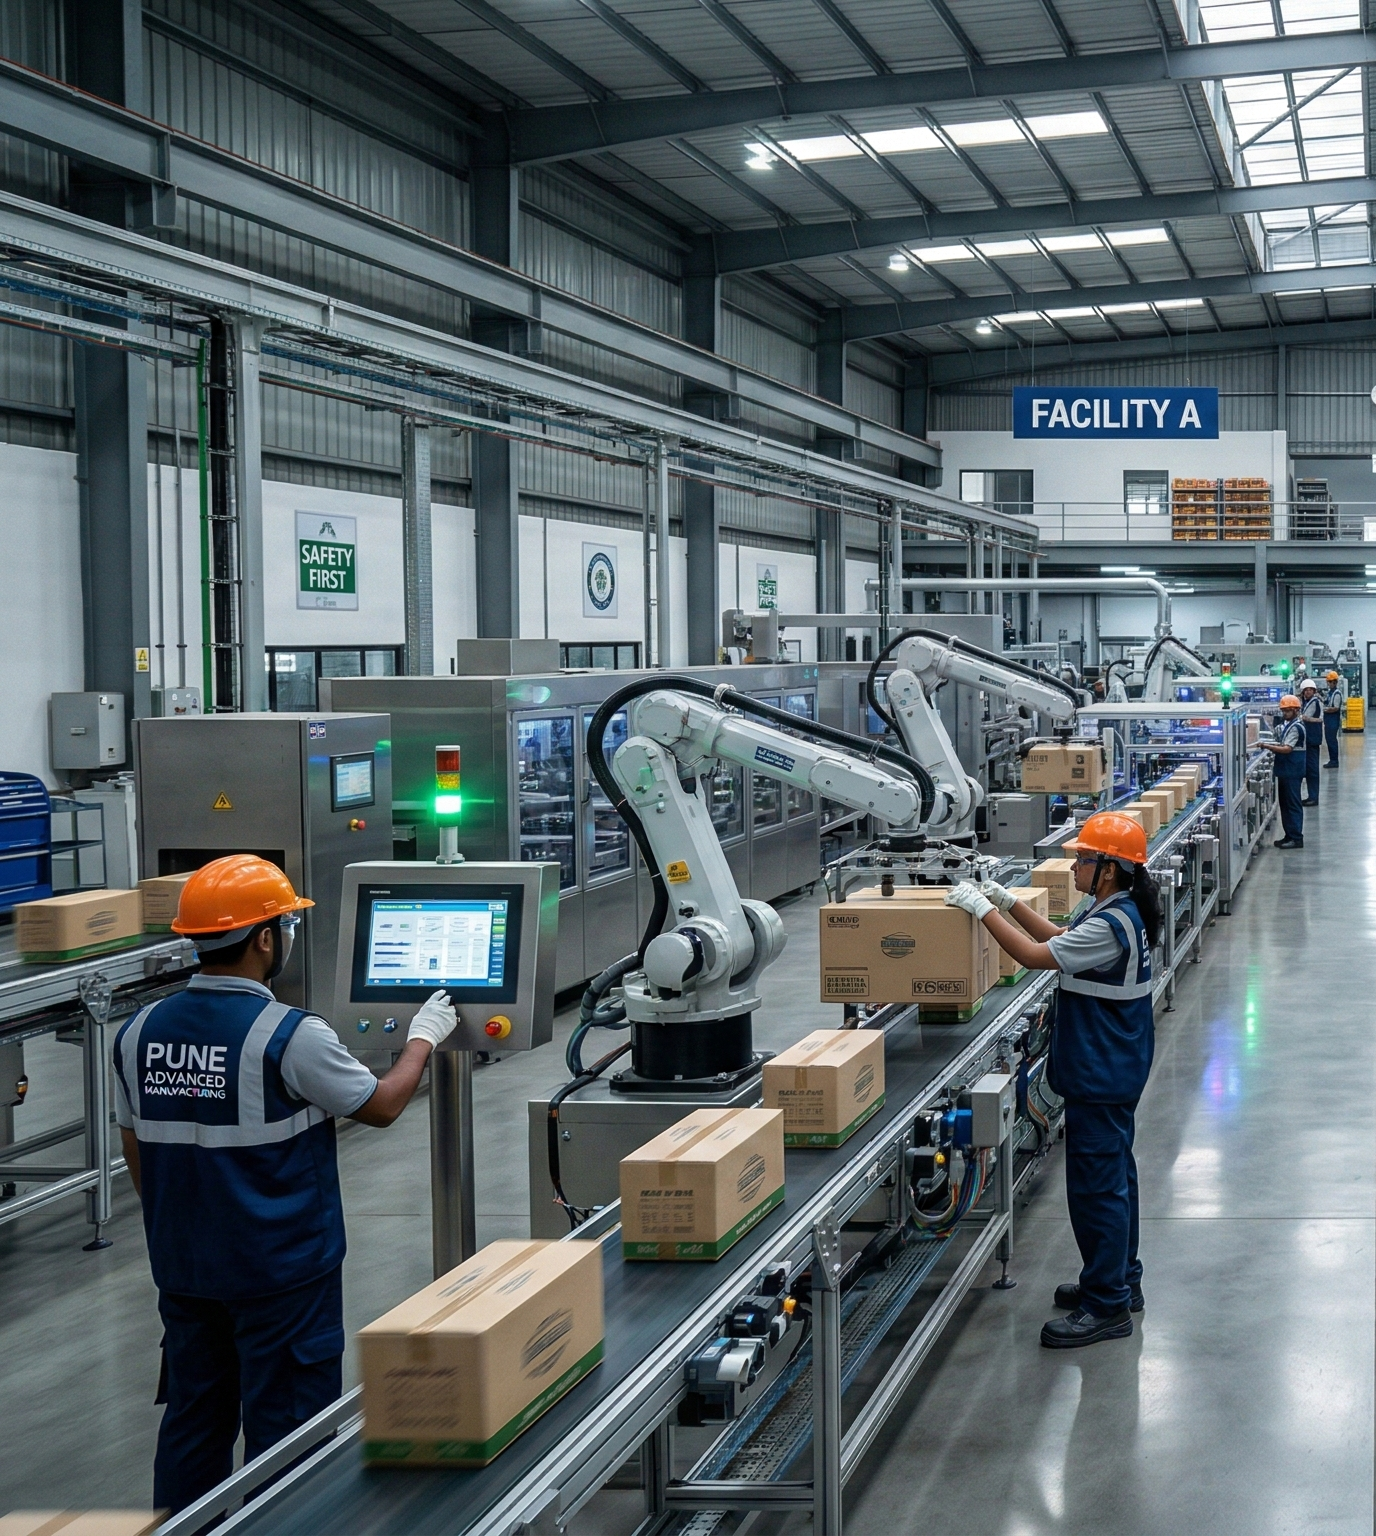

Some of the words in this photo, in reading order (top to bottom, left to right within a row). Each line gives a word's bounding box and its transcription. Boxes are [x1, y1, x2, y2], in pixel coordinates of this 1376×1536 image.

[1032, 399, 1171, 429] FACILITY
[1179, 399, 1202, 429] A
[301, 544, 353, 567] SAFETY
[309, 569, 346, 589] FIRST
[146, 1042, 228, 1072] PUNE
[144, 1071, 226, 1088] ADVANCED
